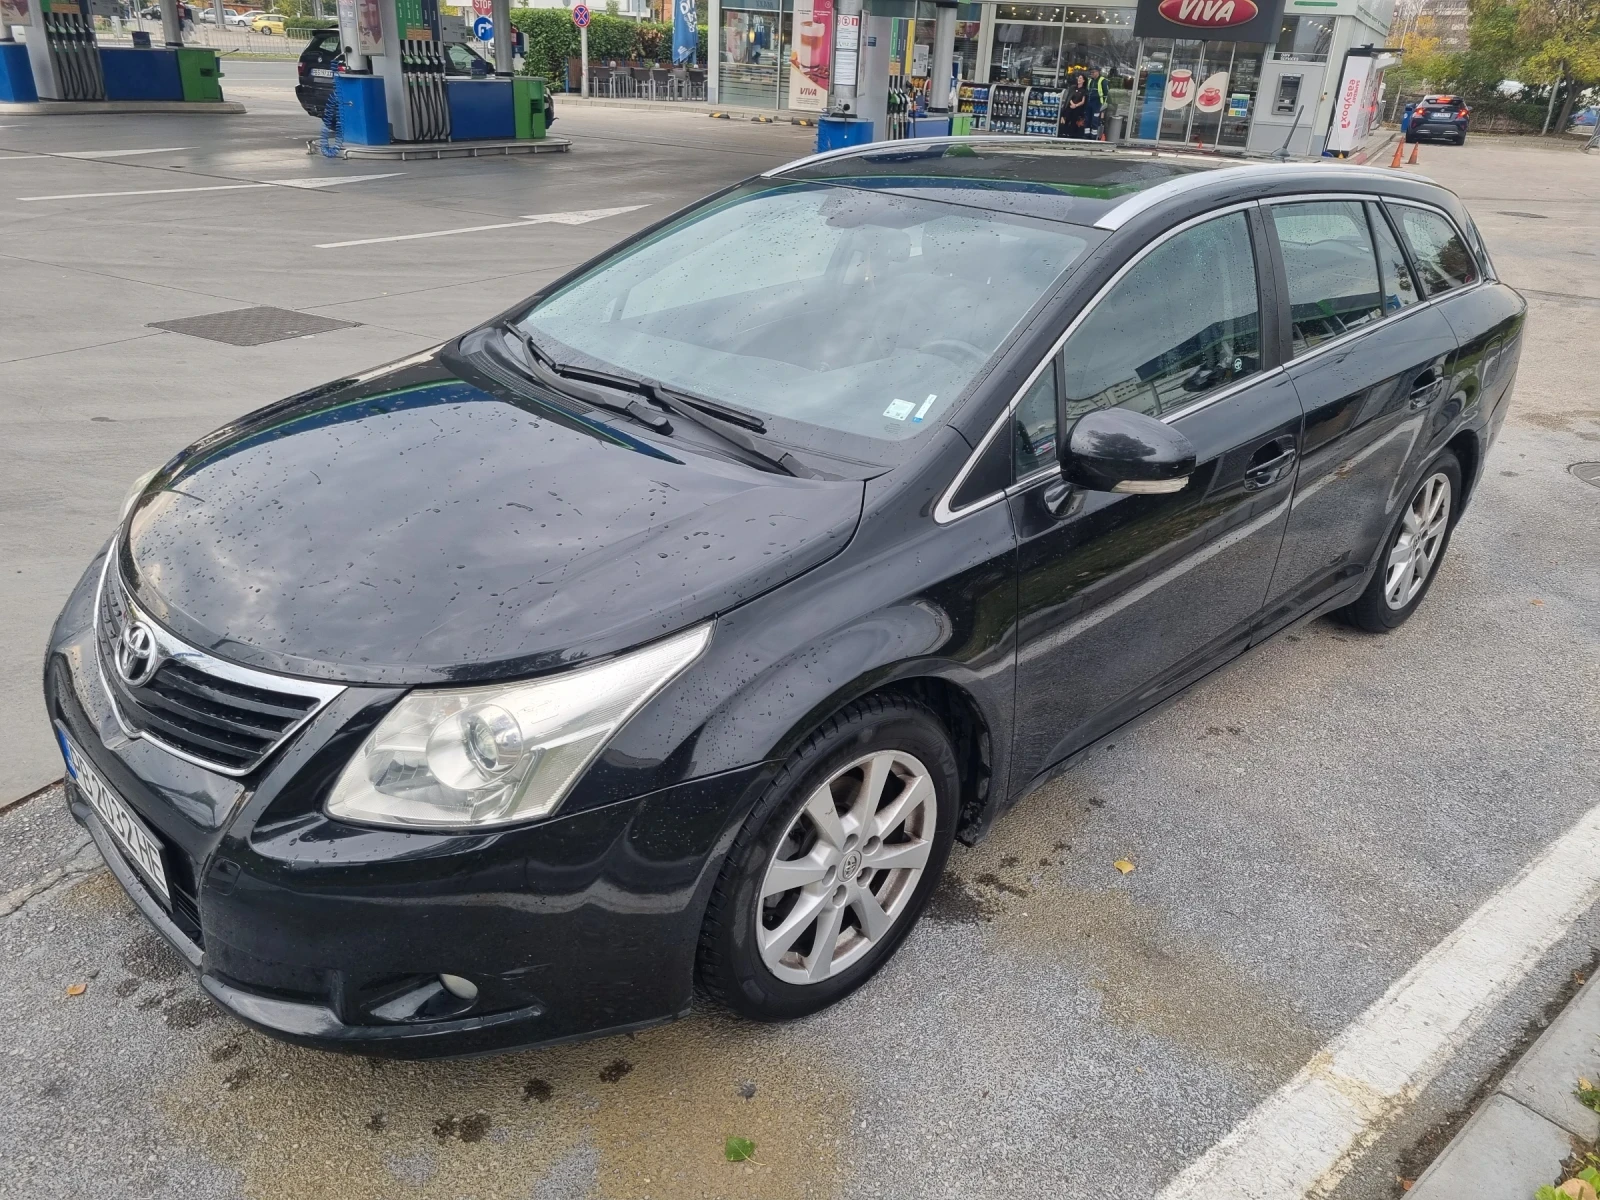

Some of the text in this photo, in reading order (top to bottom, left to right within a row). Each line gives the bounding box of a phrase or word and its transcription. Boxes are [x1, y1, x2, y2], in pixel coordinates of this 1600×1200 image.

[475, 0, 492, 9] STOP
[1178, 0, 1236, 22] VIVA
[800, 87, 817, 96] VIVA
[1340, 79, 1355, 122] easybox
[91, 775, 138, 855] 2032
[134, 823, 166, 889] HE
